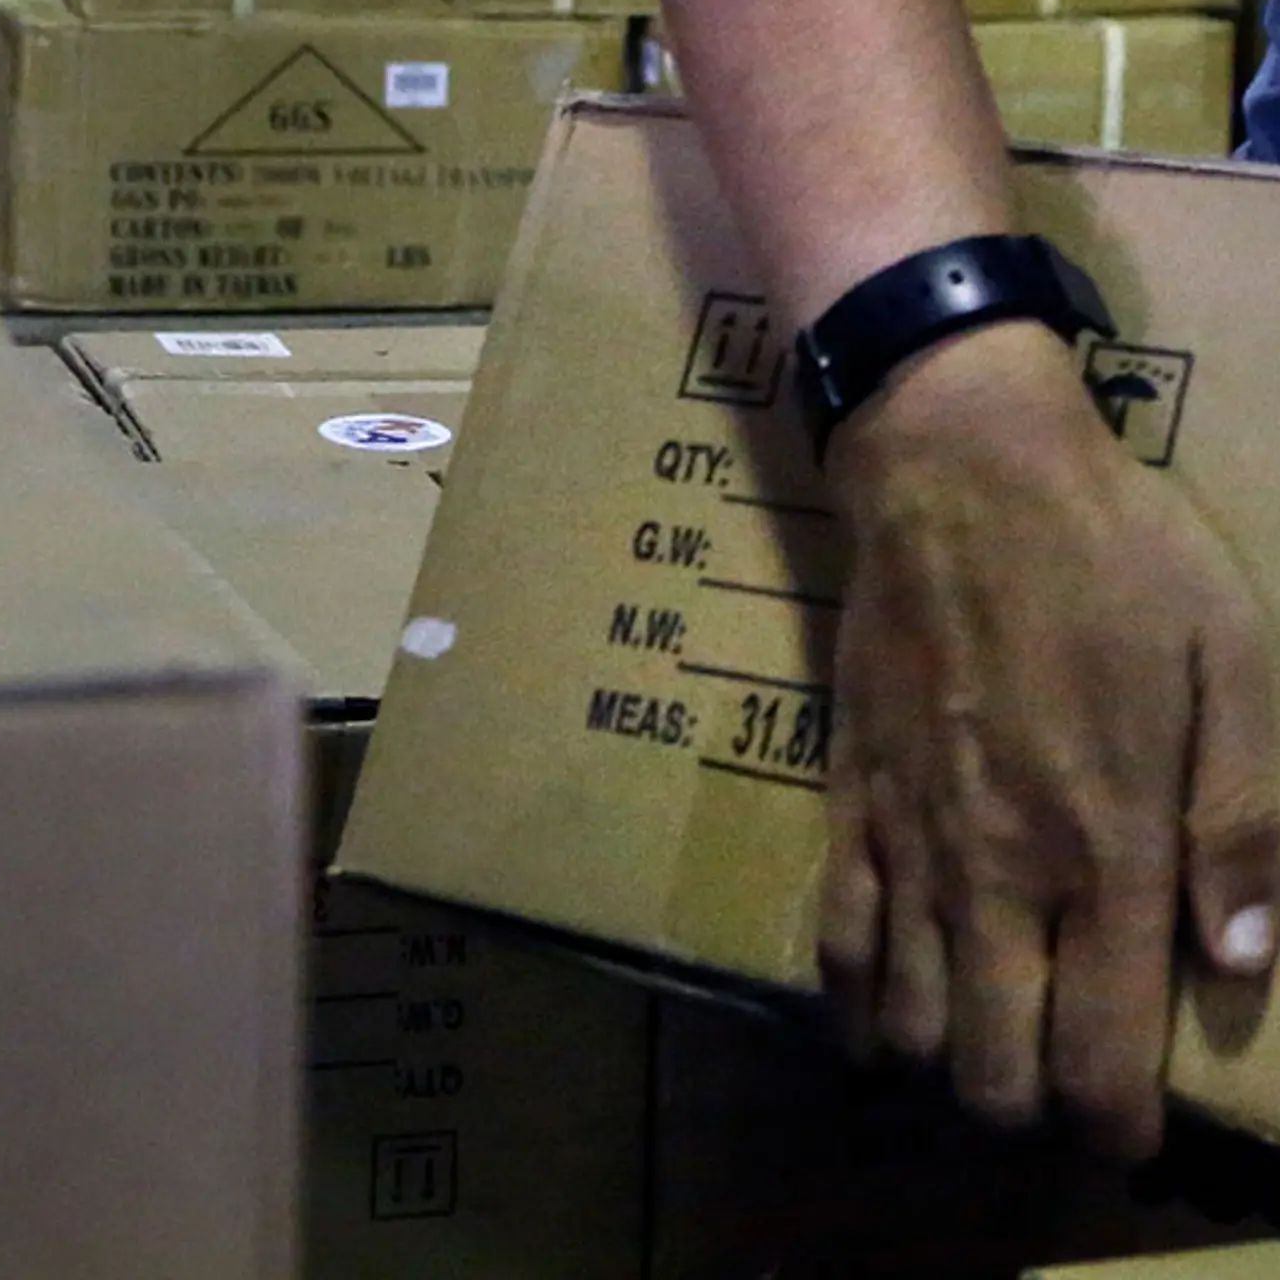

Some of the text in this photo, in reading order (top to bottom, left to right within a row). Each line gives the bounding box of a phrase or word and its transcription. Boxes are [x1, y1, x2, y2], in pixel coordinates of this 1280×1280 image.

[654, 440, 733, 488] QTY:
[632, 520, 712, 571] G.W:
[606, 602, 687, 655] N.W:
[586, 689, 699, 749] MEAS:
